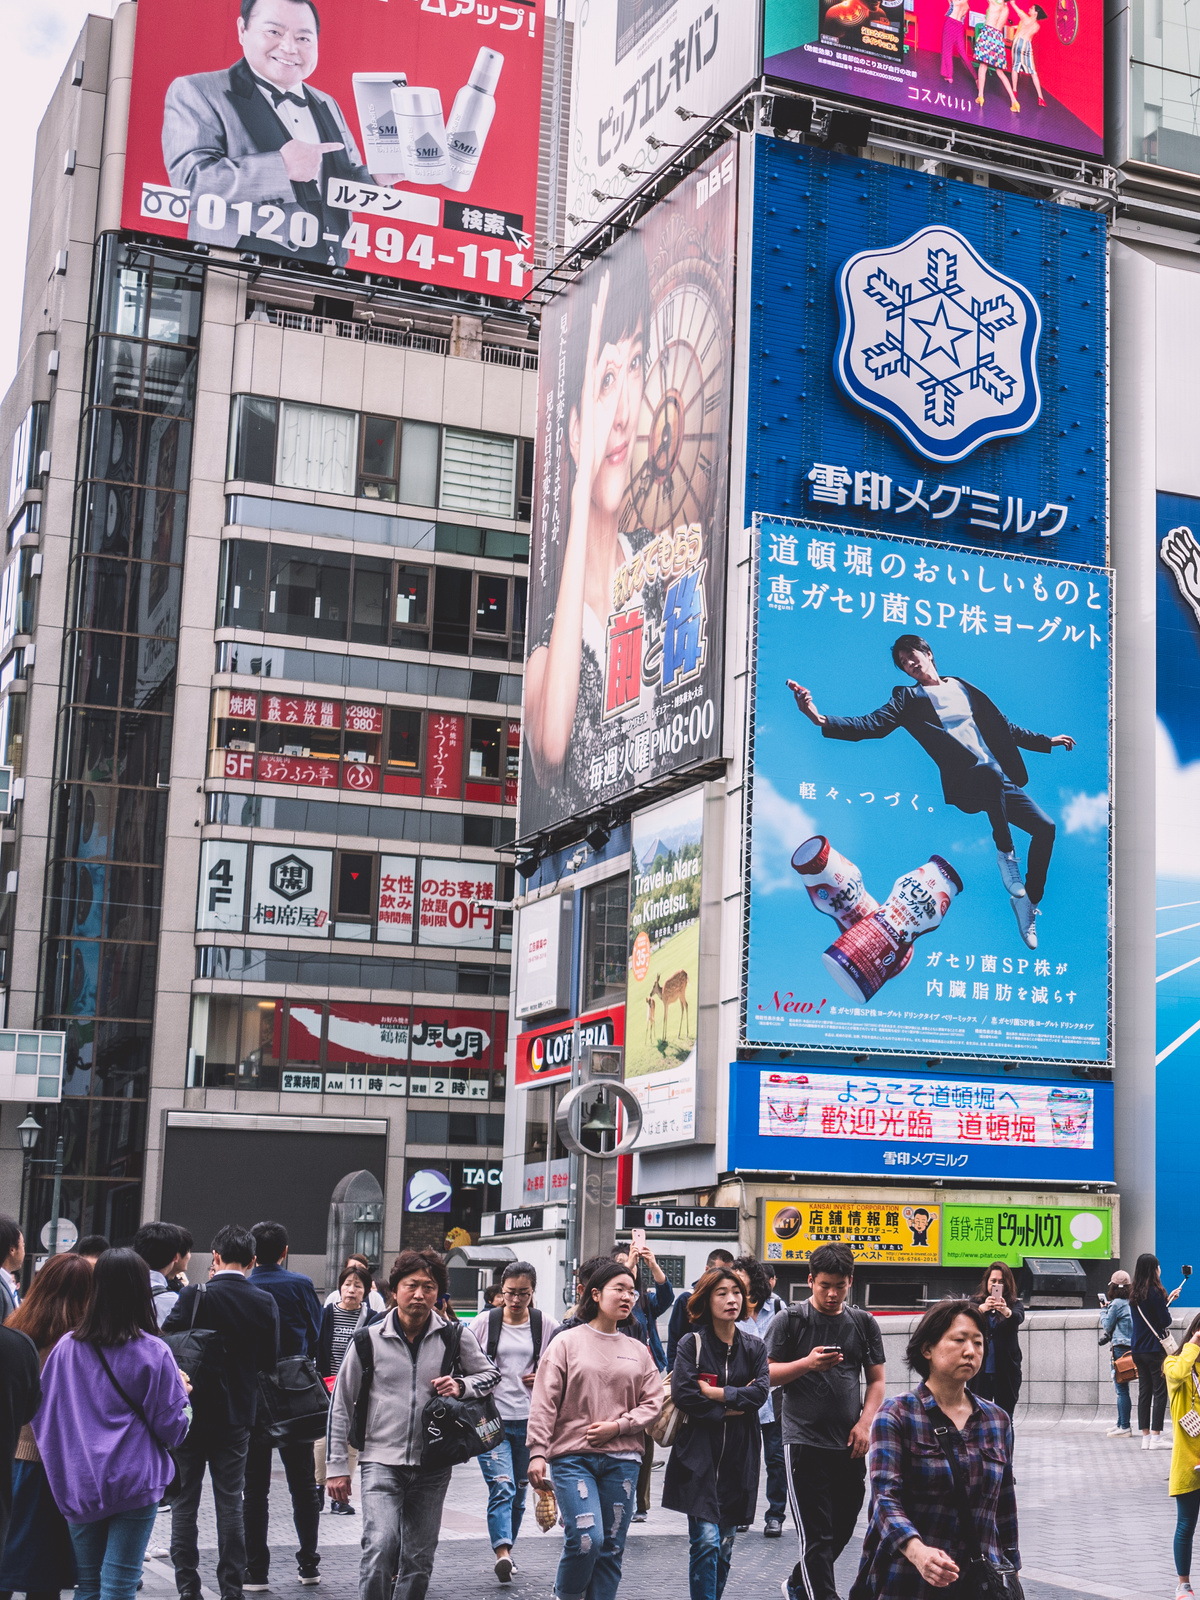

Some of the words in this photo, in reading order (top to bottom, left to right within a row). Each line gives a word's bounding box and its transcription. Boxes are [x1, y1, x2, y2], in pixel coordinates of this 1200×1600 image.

[598, 5, 719, 168] ピップエレキバン
[908, 86, 972, 112] コスパいい
[416, 147, 439, 157] SMH
[453, 139, 477, 155] SMH
[696, 151, 734, 210] MBS
[334, 183, 403, 212] ルアン
[462, 207, 506, 236] 検索
[197, 194, 524, 287] 0120-494-111
[551, 313, 568, 545] 見た目は変わりませんが、
[538, 390, 554, 587] 見る目が変わります。
[807, 462, 1069, 537] 雪印メグミルク
[613, 523, 703, 610] 教えてもらう
[767, 532, 1102, 610] 道頓堀のおいしいものと
[604, 562, 707, 722] 前と後
[230, 696, 256, 716] 焼肉
[268, 695, 334, 714] 食べ放題
[267, 710, 334, 728] 飲み放題
[449, 717, 457, 747] 炭火焼肉
[225, 754, 253, 777] 5F
[430, 715, 450, 796] ふうふう亭
[261, 764, 333, 787] ふうふう亭
[350, 765, 371, 786] ふ
[799, 781, 934, 813] 軽々、つづく。
[208, 859, 233, 912] 4F
[279, 865, 304, 891] 相席
[634, 865, 665, 896] Travel
[665, 871, 673, 885] to
[673, 857, 699, 882] Nara
[253, 903, 319, 928] 相席屋
[448, 900, 493, 930] 0円
[632, 913, 642, 927] on
[643, 893, 689, 924] Kintetsu.
[926, 951, 1068, 978] ガセリ菌SP株が
[758, 990, 827, 1015] New!
[926, 978, 1078, 1005] 内臓脂肪を減らす
[380, 1030, 407, 1045] 鶴橋
[412, 1020, 483, 1060] 風月
[284, 1074, 320, 1090] 営業時間
[837, 1080, 1020, 1110] ようこそ道頓堀へ
[957, 1111, 1036, 1143] 道頓堀
[882, 1151, 969, 1168] 雪印メグミルク
[513, 1213, 531, 1229] Toilets
[666, 1211, 716, 1227] Toilets
[809, 1210, 899, 1227] 店舗情報館
[856, 1204, 899, 1212] CORPORATION
[808, 1226, 899, 1234] 居抜き店舗総合プロデュース
[950, 1216, 995, 1243] 賃貸・売買
[997, 1212, 1064, 1249] ピタットハウス
[947, 1251, 1008, 1260] http://www.pitat.com/
